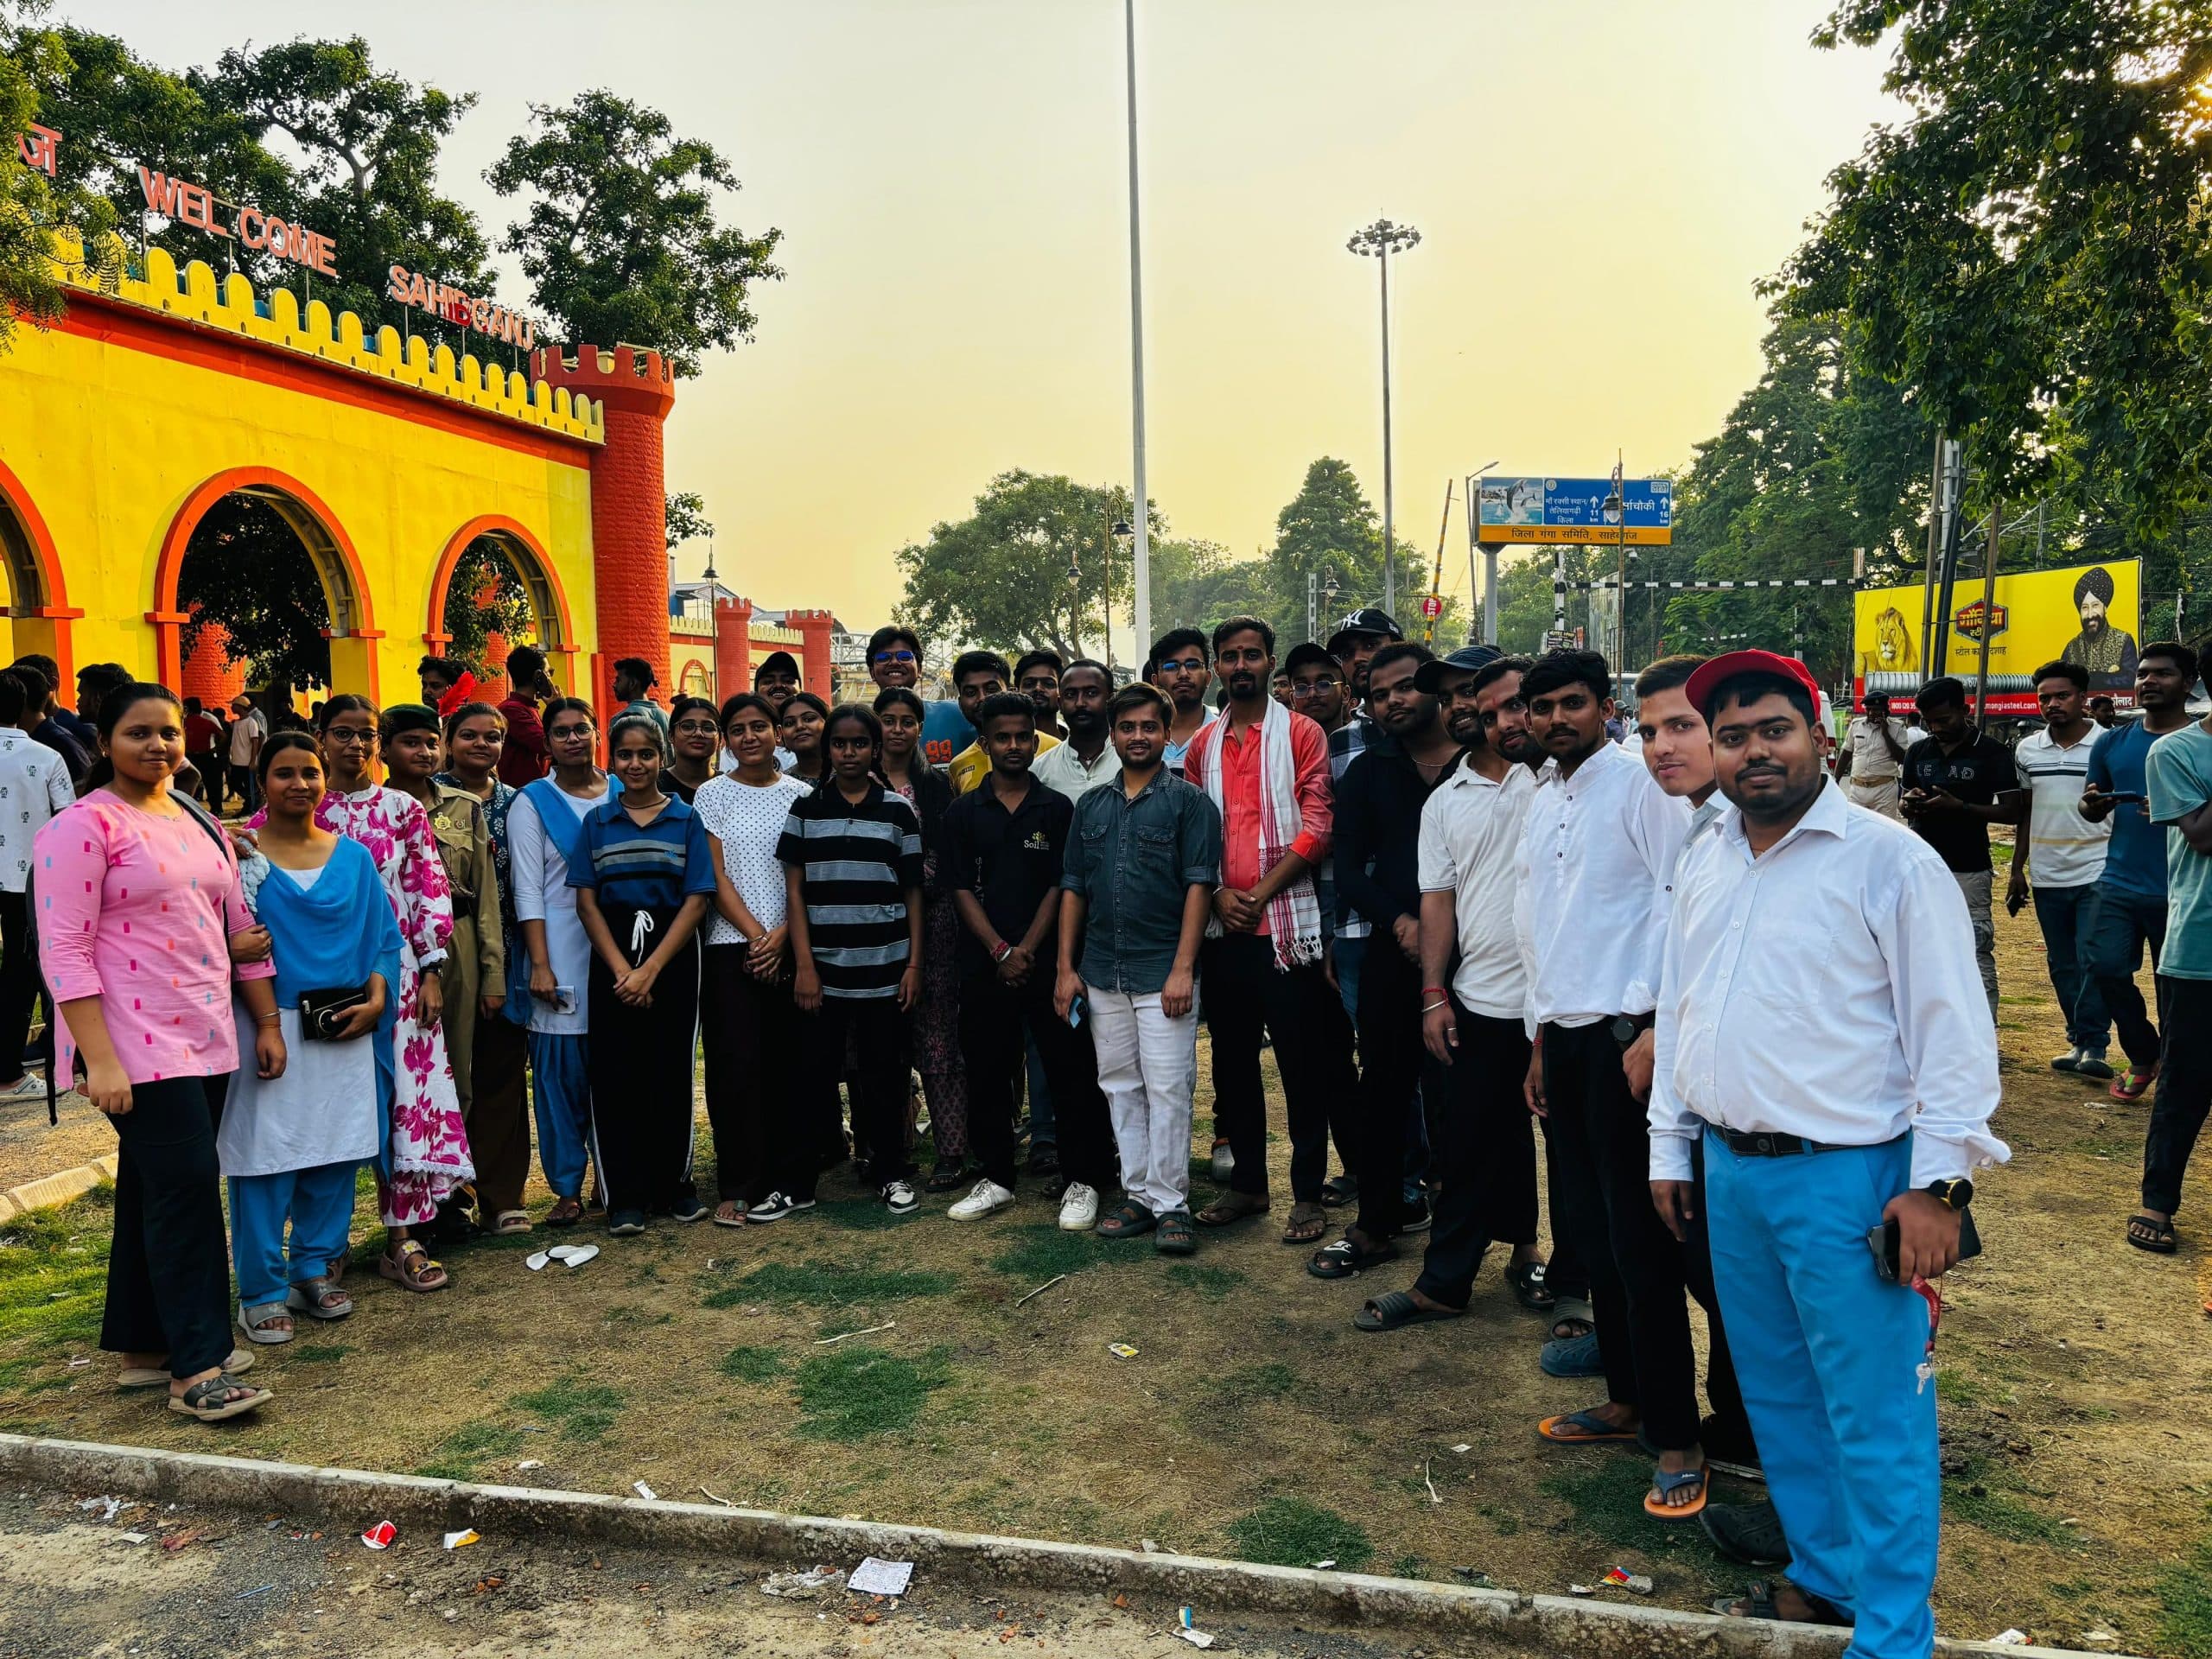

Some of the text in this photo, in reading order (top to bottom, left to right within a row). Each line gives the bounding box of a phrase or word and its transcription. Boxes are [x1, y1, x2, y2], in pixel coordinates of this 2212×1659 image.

[1511, 528, 1534, 538] जिला
[1540, 528, 1556, 538] गंगा
[1427, 598, 1437, 616] STOP
[1024, 839, 1039, 849] Soil
[1535, 1266, 1546, 1274] NI
